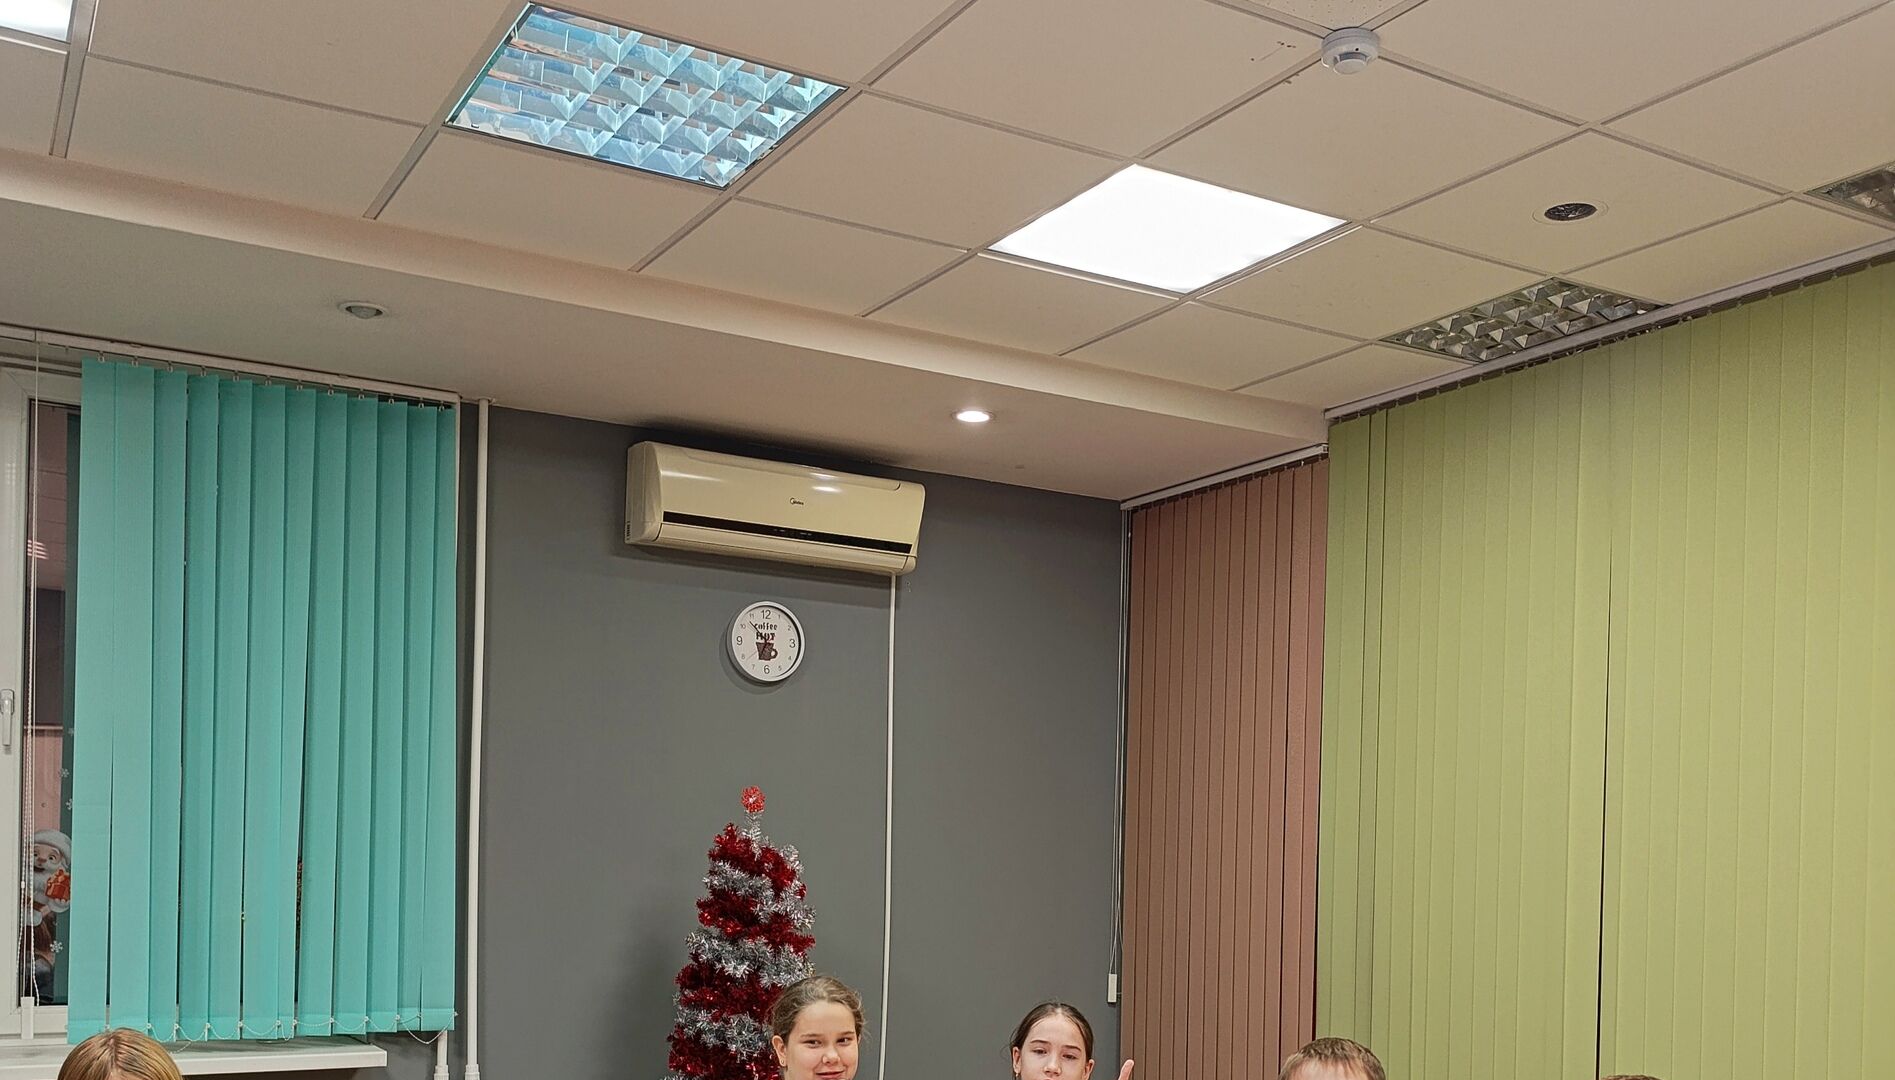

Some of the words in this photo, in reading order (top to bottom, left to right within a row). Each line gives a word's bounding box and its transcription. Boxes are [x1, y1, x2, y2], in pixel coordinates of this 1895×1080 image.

[761, 610, 772, 620] 12
[736, 636, 743, 645] 9
[789, 639, 796, 648] 3
[764, 665, 770, 674] 6
